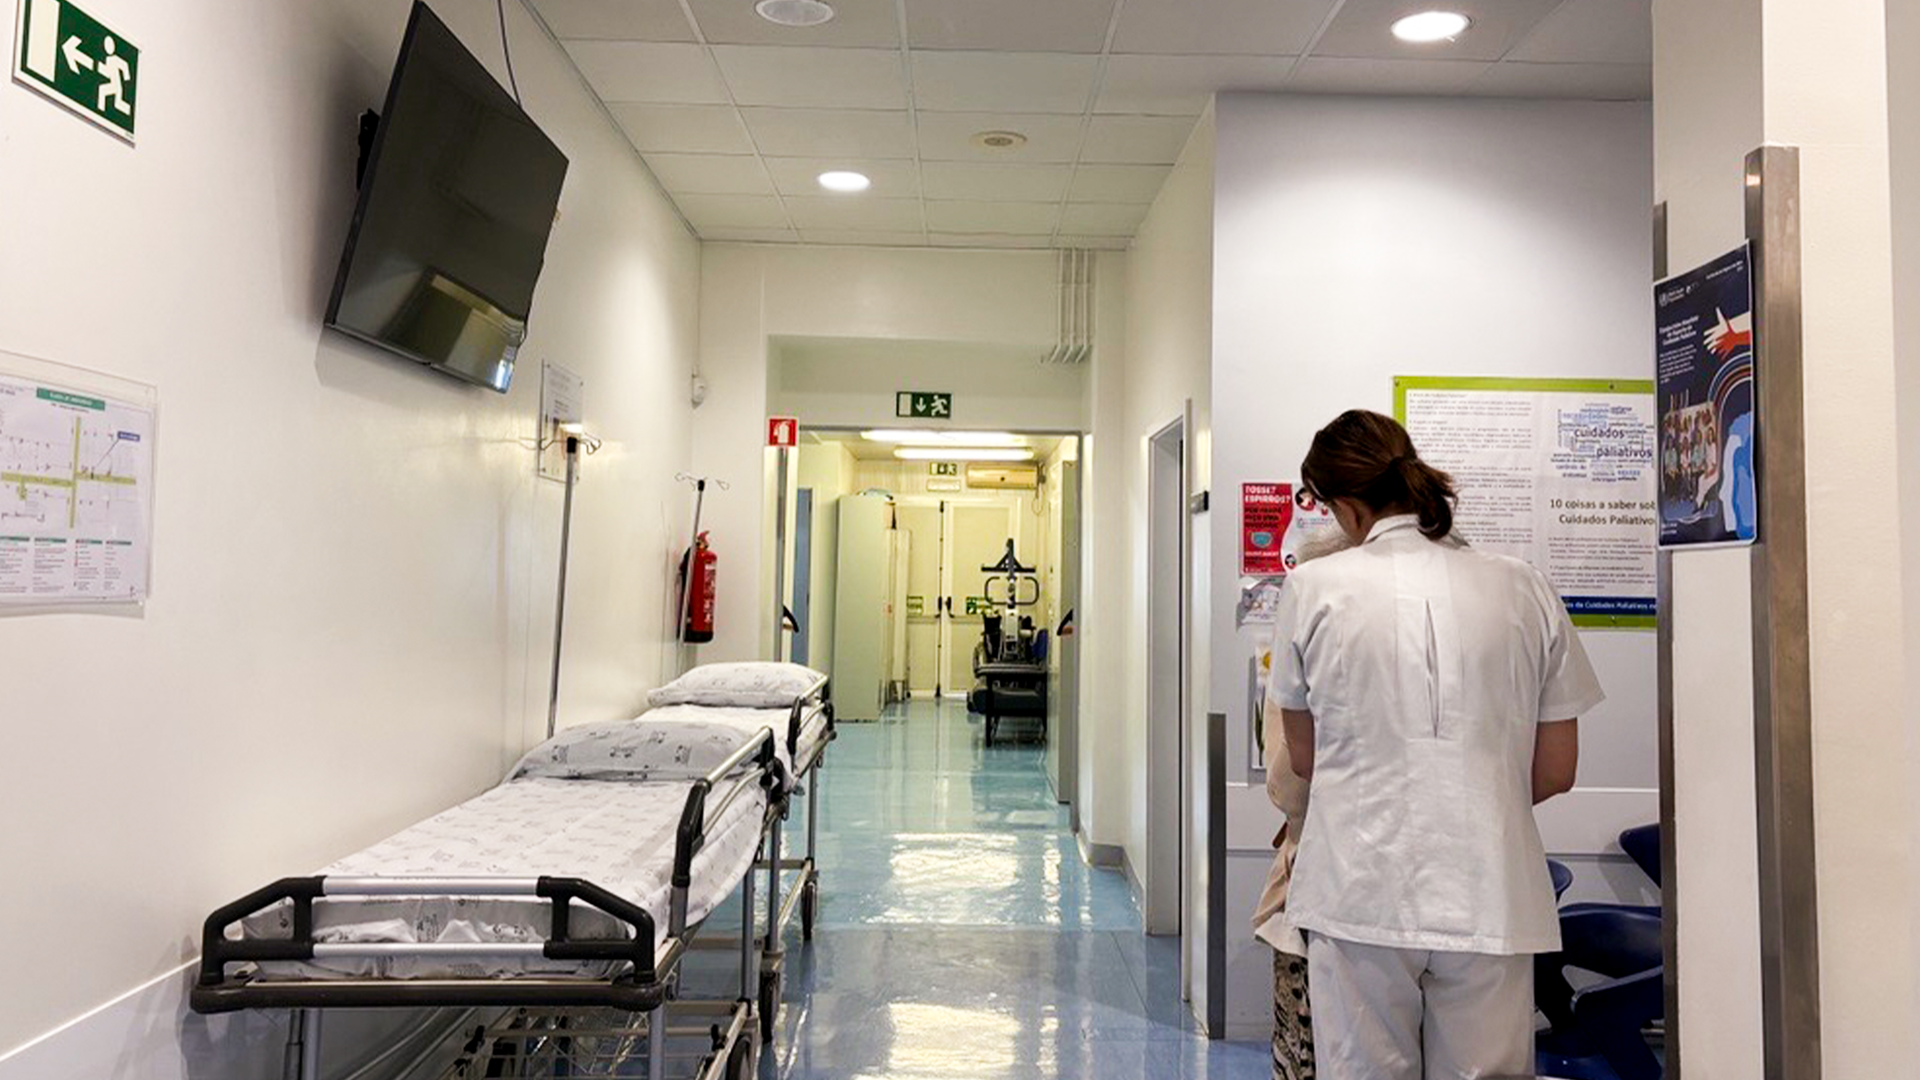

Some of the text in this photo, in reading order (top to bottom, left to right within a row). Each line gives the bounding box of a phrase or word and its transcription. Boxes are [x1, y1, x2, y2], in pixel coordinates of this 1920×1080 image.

[1574, 427, 1625, 438] cuidados
[1596, 446, 1652, 460] paliativos
[1245, 485, 1276, 494] TOSSE?
[1245, 495, 1291, 503] ESPIRROS?
[1549, 498, 1562, 509] 10
[1565, 499, 1596, 510] coisas
[1608, 500, 1636, 510] saber
[1559, 515, 1607, 524] Cuidados
[1585, 600, 1615, 609] Cuidados
